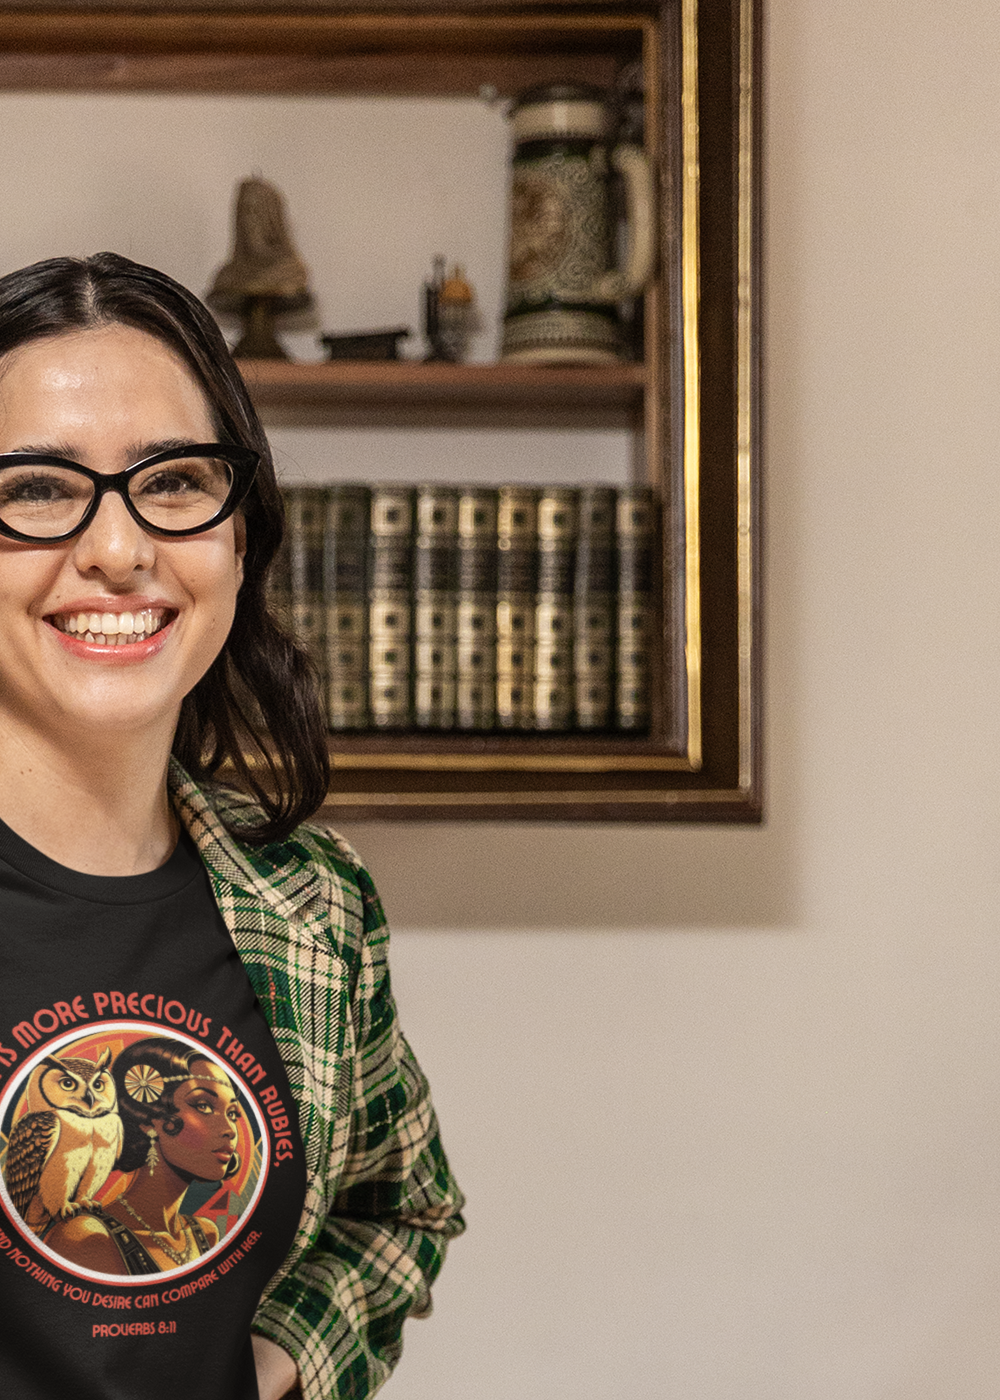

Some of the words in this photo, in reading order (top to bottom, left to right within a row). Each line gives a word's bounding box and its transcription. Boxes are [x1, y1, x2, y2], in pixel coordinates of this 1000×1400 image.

[11, 994, 91, 1050] MORE
[92, 990, 213, 1039] PRECIOUS
[215, 1025, 267, 1086] THAN
[258, 1084, 295, 1169] RUBIES,
[5, 1246, 64, 1293] NOTHING
[62, 1282, 92, 1304] YOU
[91, 1292, 133, 1310] DESIRE
[134, 1293, 160, 1309] CAN
[161, 1269, 220, 1304] COMPARE
[216, 1248, 245, 1275] WITH
[240, 1230, 263, 1253] HER.
[92, 1320, 156, 1338] PROVERBS
[157, 1320, 177, 1335] 8:11
